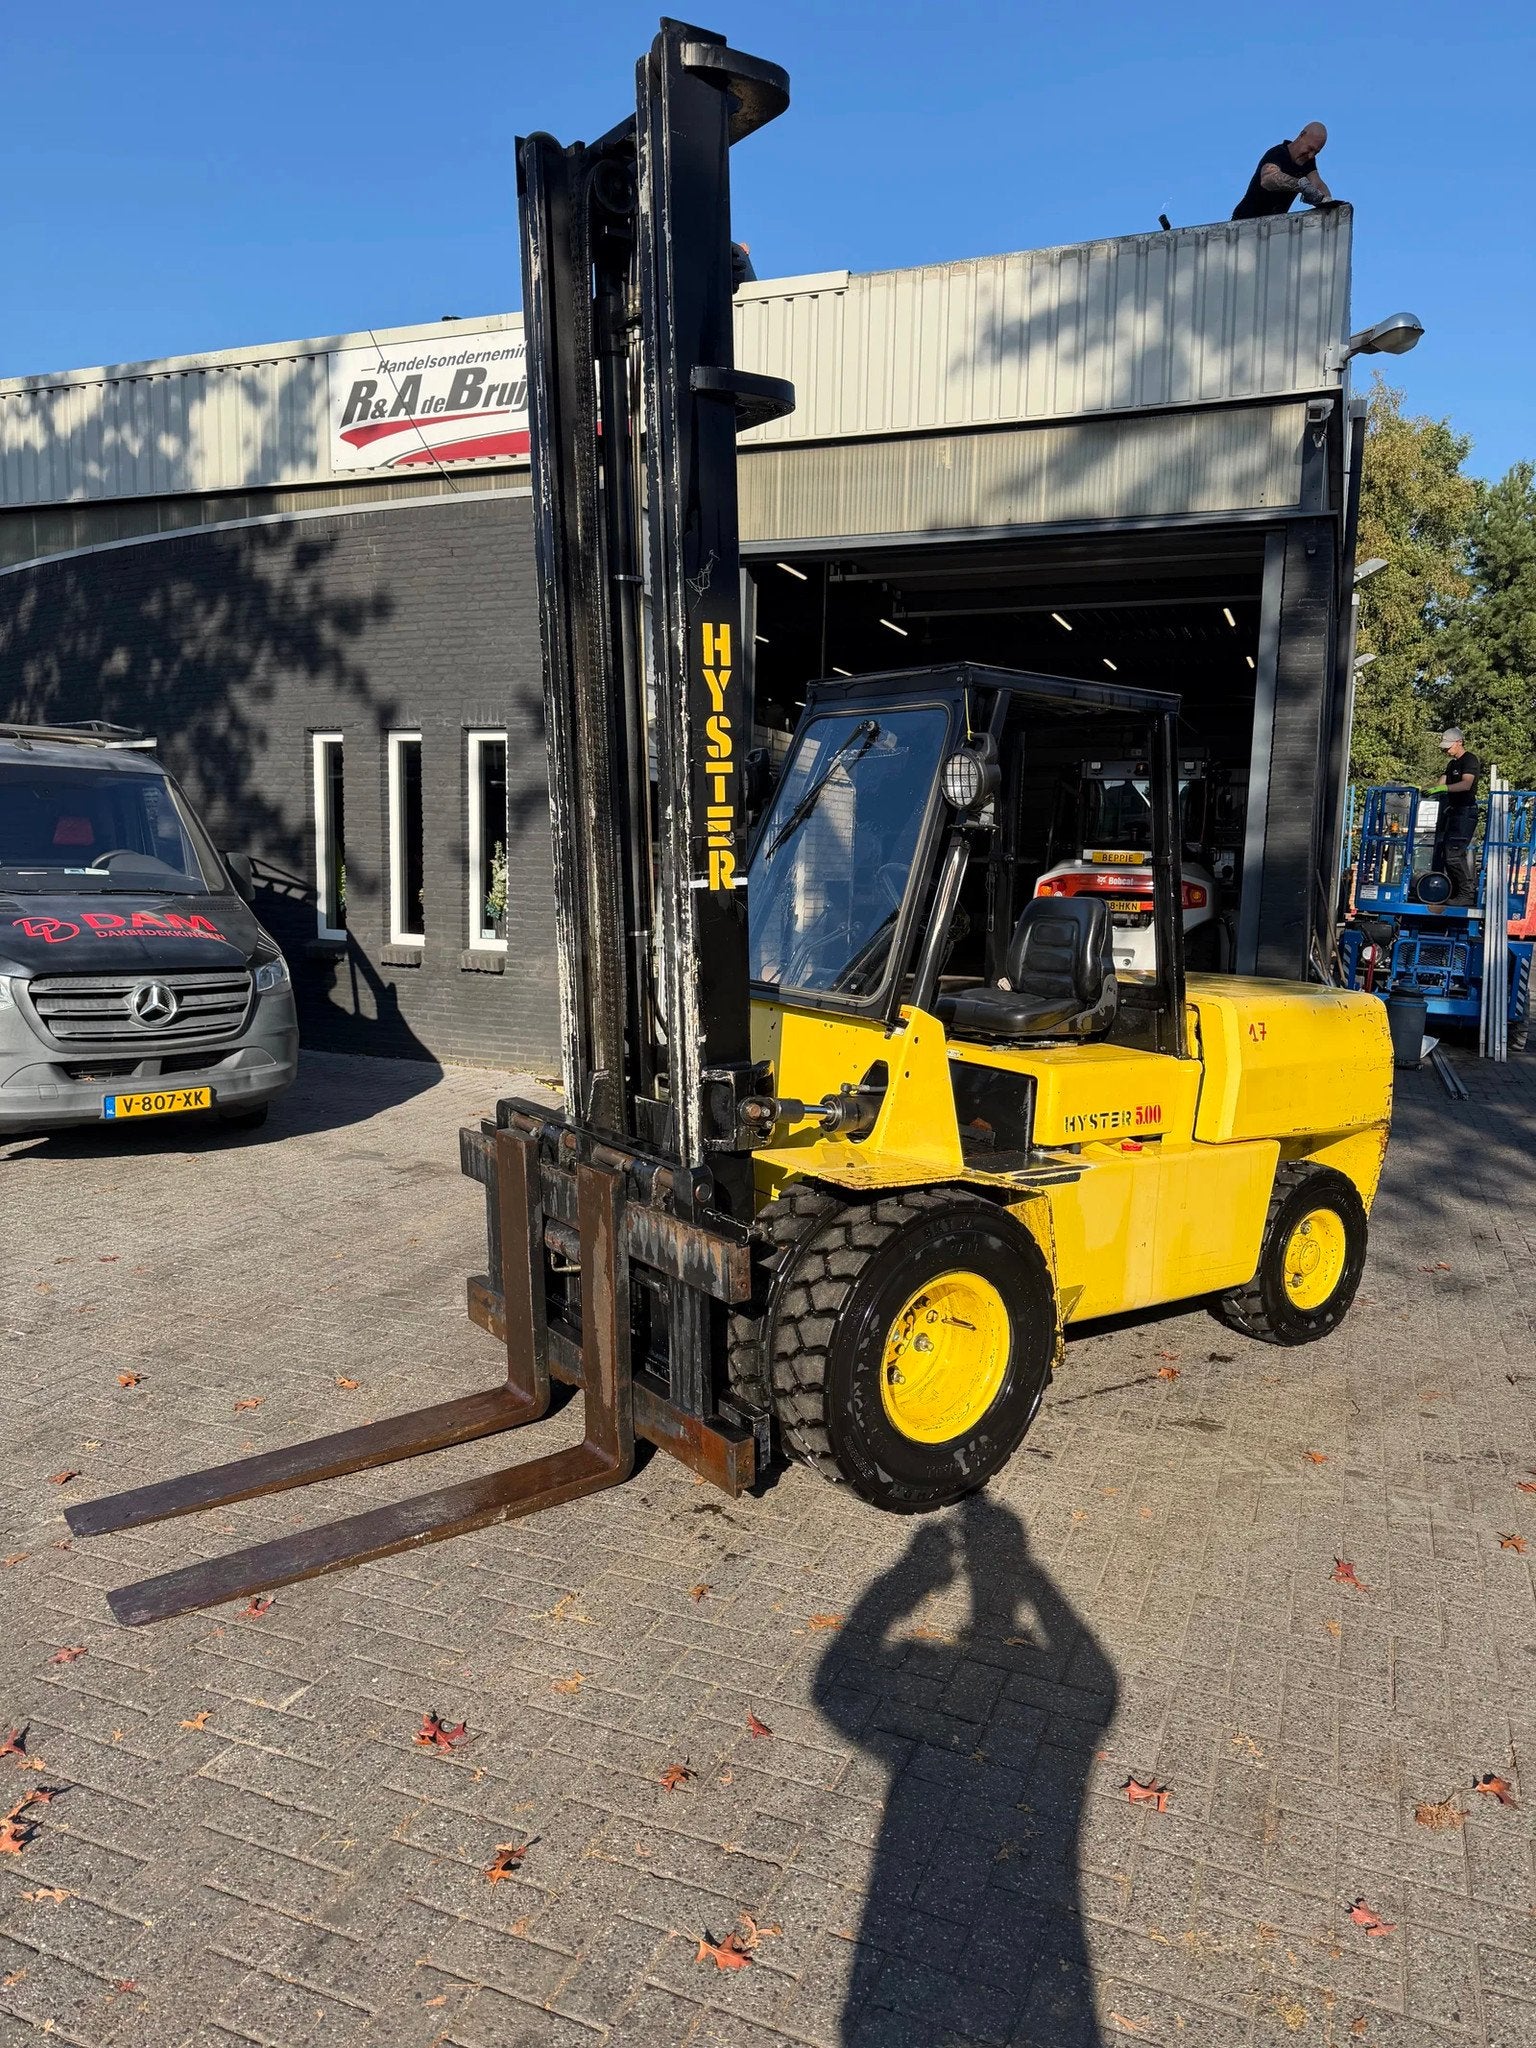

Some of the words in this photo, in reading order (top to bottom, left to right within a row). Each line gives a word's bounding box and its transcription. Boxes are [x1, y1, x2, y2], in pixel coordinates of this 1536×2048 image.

[339, 373, 423, 429] R&A
[421, 395, 447, 415] de
[444, 366, 529, 413] Bruij
[702, 622, 737, 891] HYSTER
[1102, 853, 1134, 863] BEPPIE
[1108, 876, 1134, 886] Bobcat
[81, 912, 218, 932] DAM
[95, 929, 227, 941] DAKBEDEKKINGEN
[1248, 1022, 1267, 1042] 17
[123, 1091, 204, 1113] V-807-XK
[1065, 1110, 1132, 1133] HYSTER
